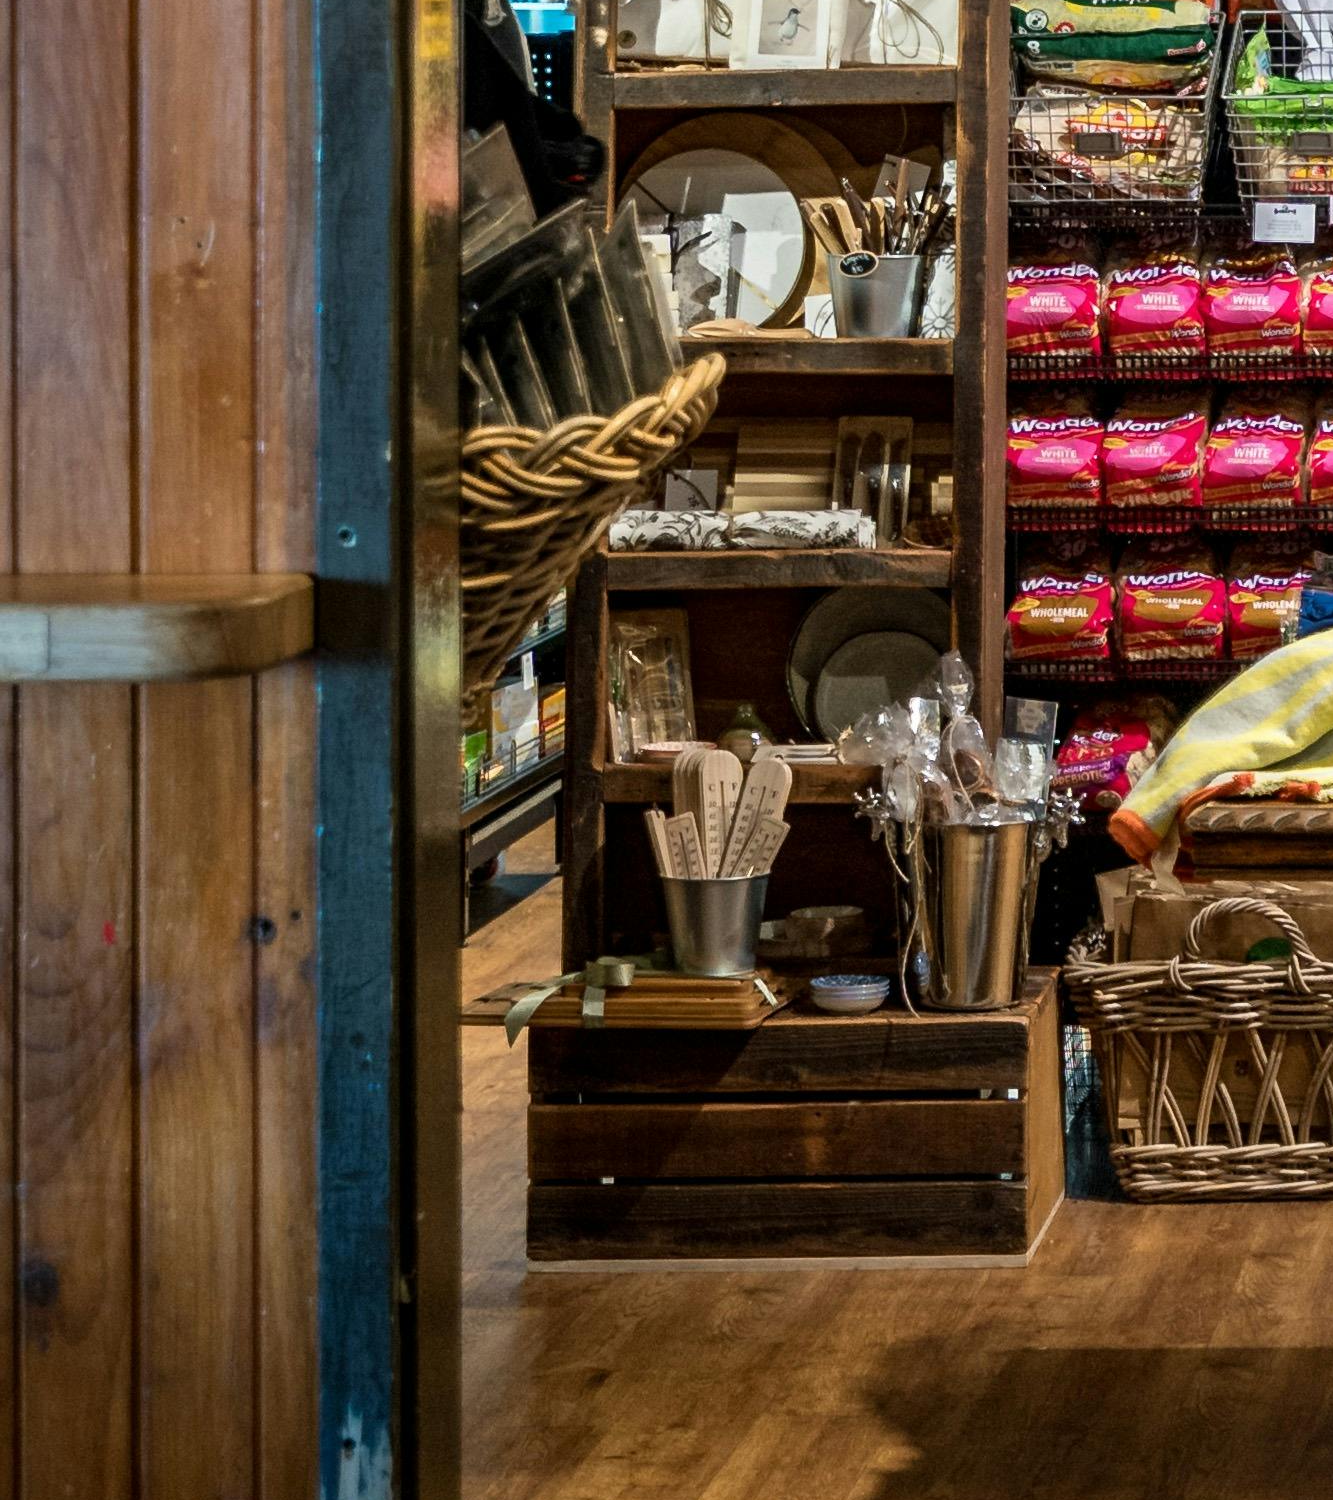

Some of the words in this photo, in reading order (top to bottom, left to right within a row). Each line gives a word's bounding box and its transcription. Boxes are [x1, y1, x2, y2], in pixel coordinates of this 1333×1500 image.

[1029, 295, 1067, 308] WHITE
[1141, 292, 1179, 306] WHITE
[1040, 448, 1078, 459] WHITE
[1233, 447, 1271, 459] WHITE
[1030, 607, 1089, 619] WHOLEMEAL
